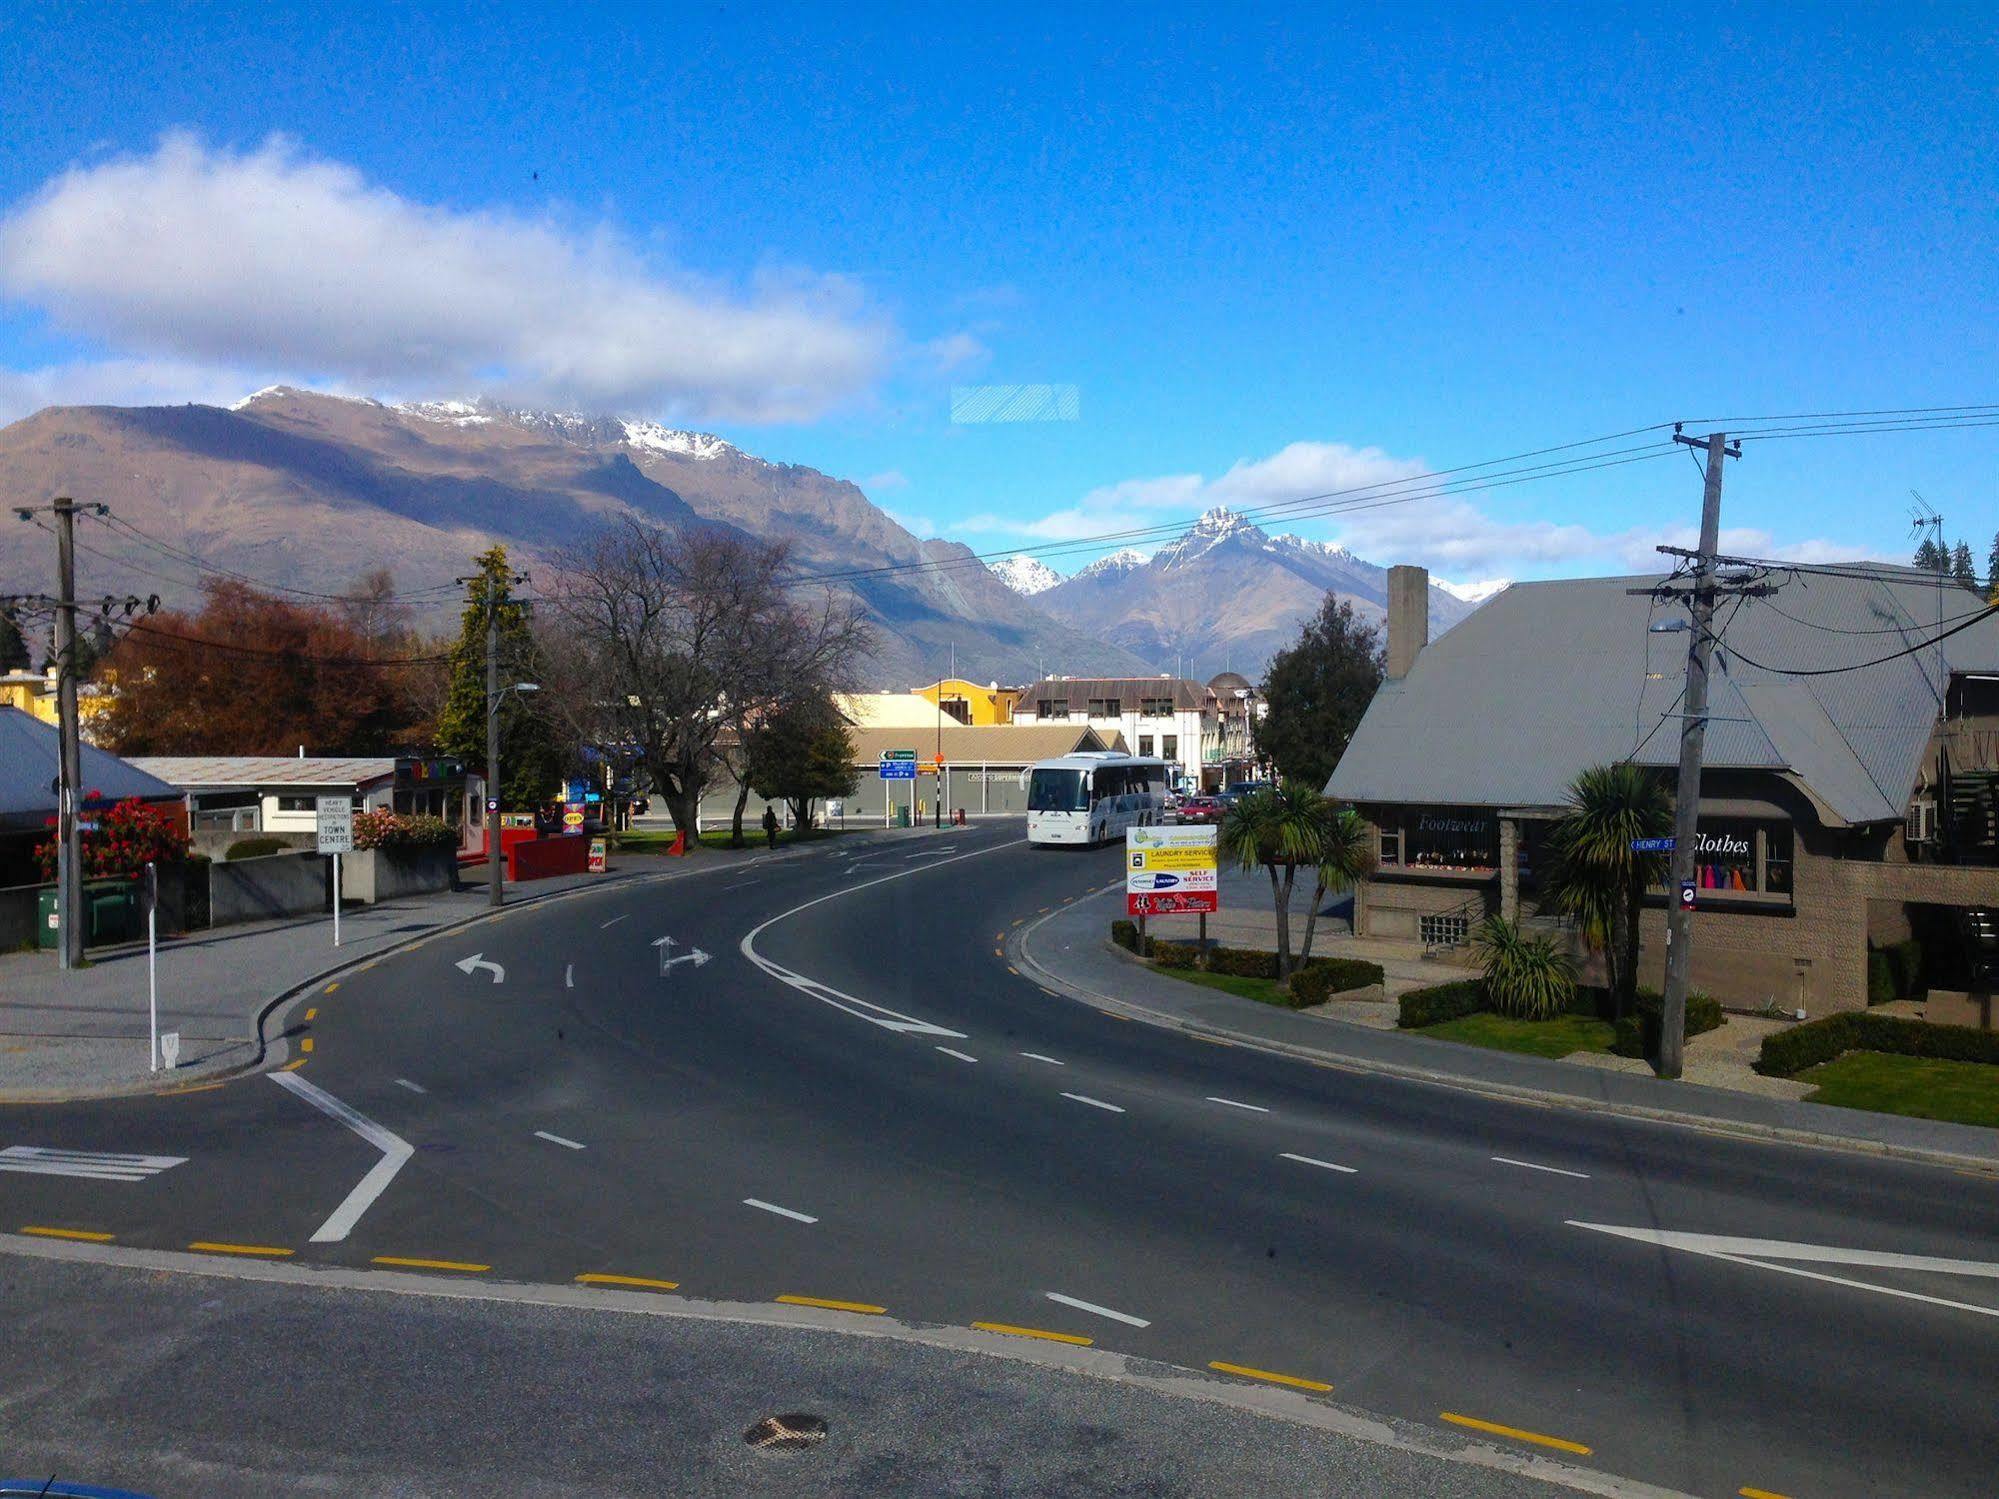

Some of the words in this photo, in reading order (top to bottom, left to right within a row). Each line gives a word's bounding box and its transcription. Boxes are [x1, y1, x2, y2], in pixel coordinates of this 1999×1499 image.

[1418, 813, 1486, 832] Footwear
[324, 826, 345, 834] TOWN
[319, 835, 350, 844] CENTRE
[1635, 839, 1660, 849] HENRY
[1664, 839, 1673, 848] ST
[1151, 849, 1182, 858] LAUNDRY
